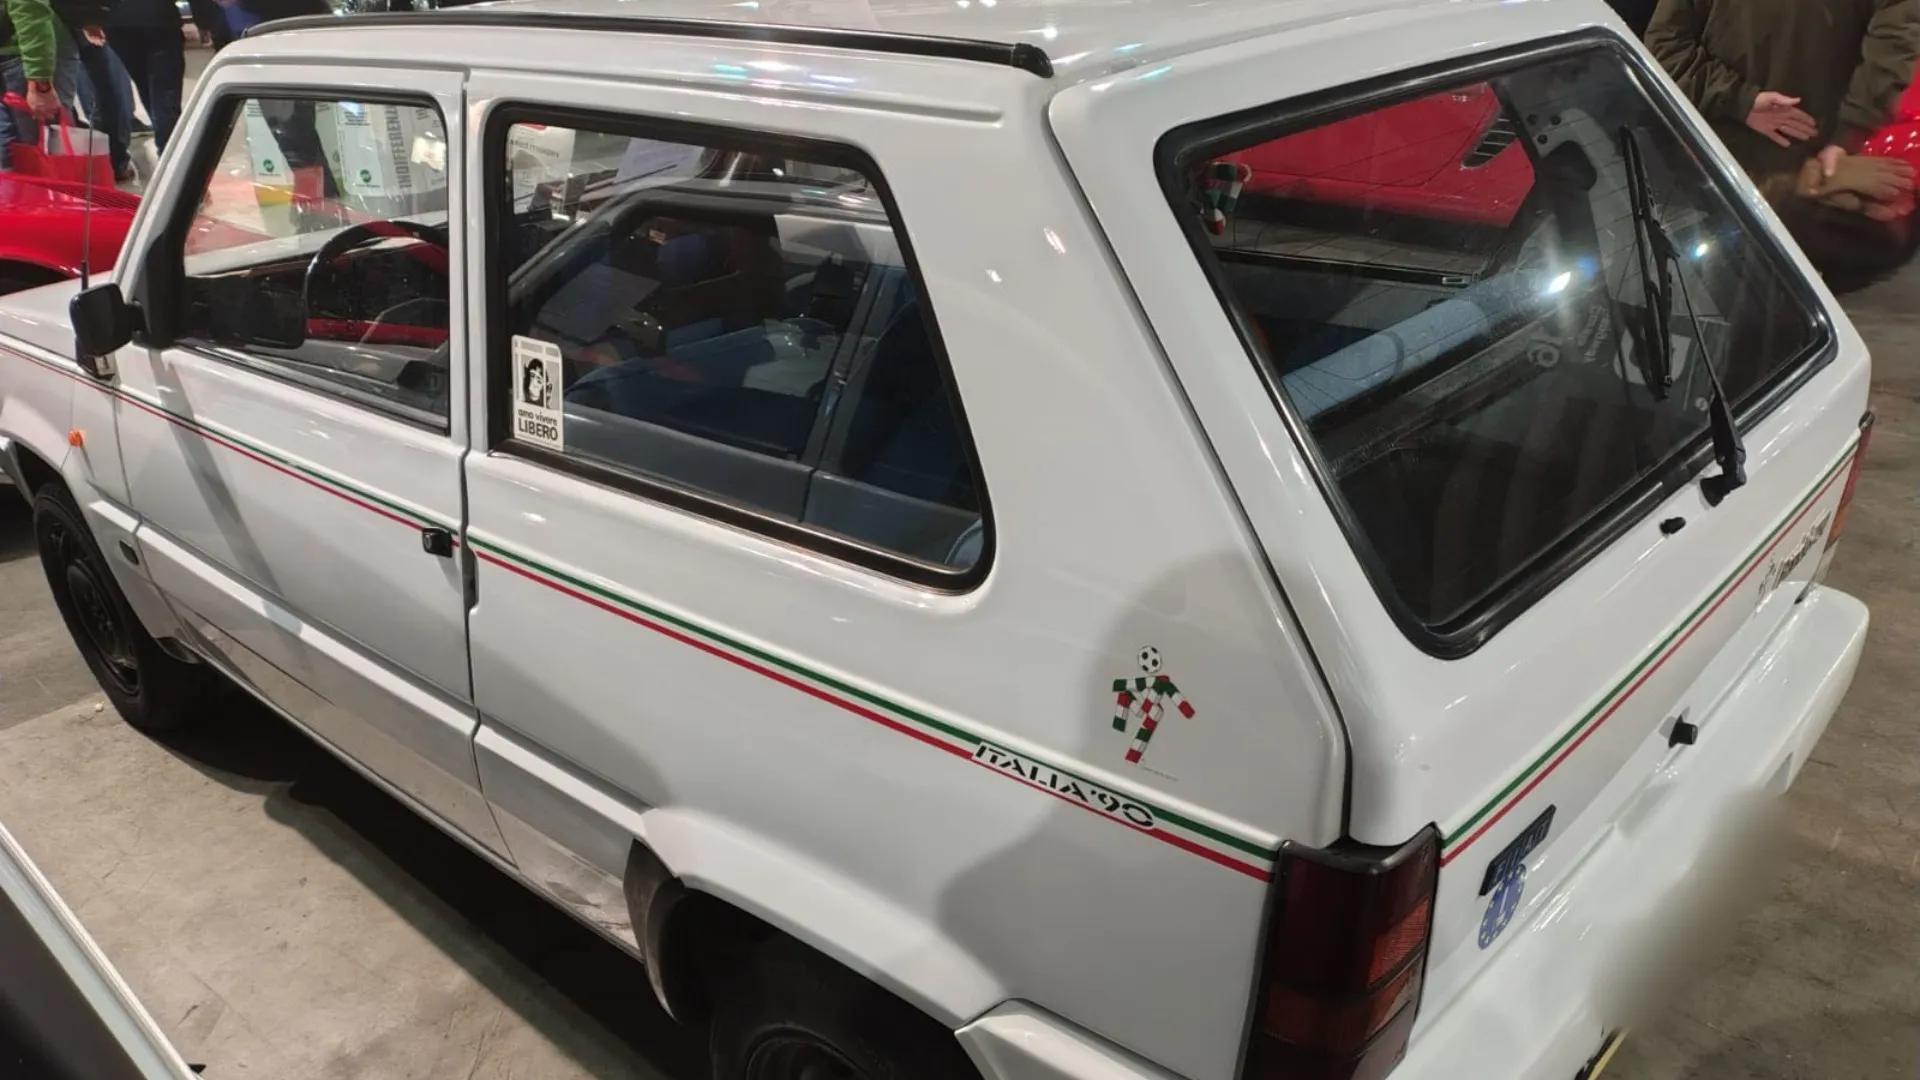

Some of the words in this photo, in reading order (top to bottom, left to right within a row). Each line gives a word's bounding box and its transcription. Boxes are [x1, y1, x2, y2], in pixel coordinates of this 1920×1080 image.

[518, 409, 534, 420] amo
[535, 411, 557, 427] vivere
[518, 418, 558, 441] LIBERO
[975, 745, 1154, 828] ITALIA'90
